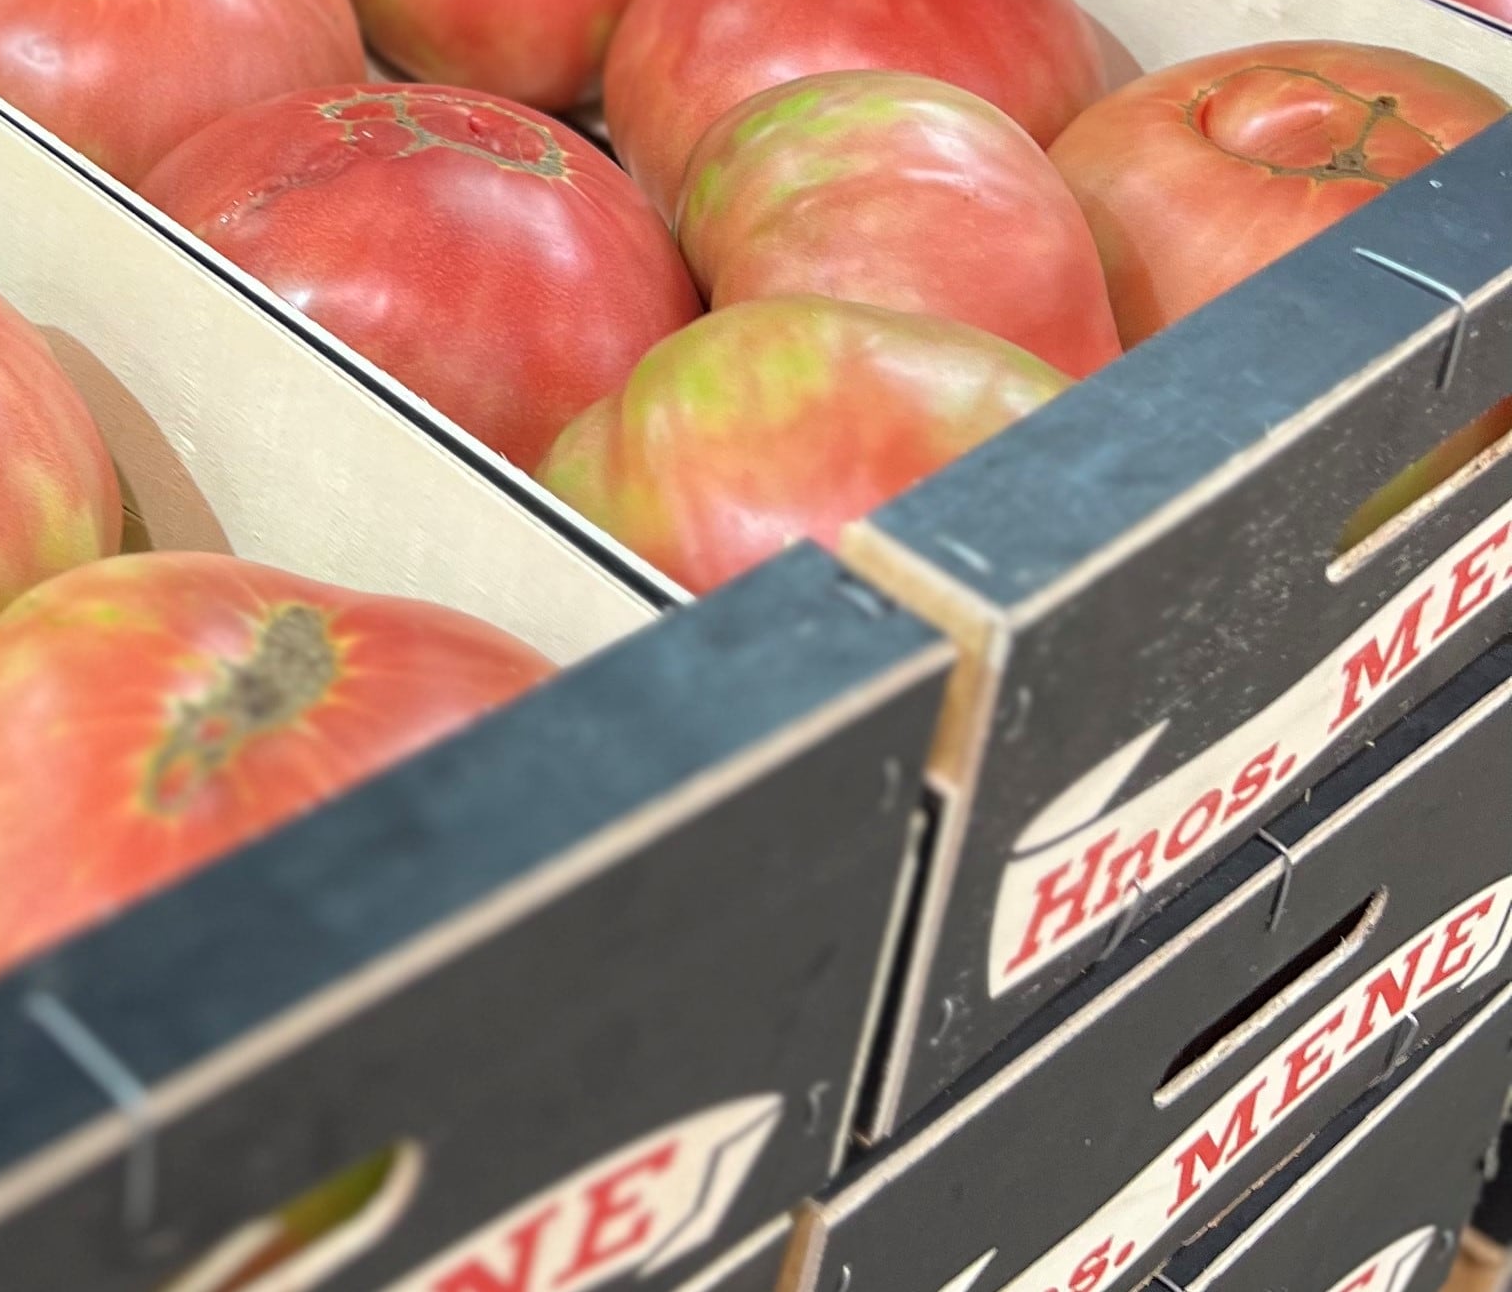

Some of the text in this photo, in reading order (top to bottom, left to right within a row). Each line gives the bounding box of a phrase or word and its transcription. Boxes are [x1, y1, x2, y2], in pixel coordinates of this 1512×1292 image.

[1002, 519, 1512, 978] Hnos. ME
[1166, 894, 1497, 1219] MENE
